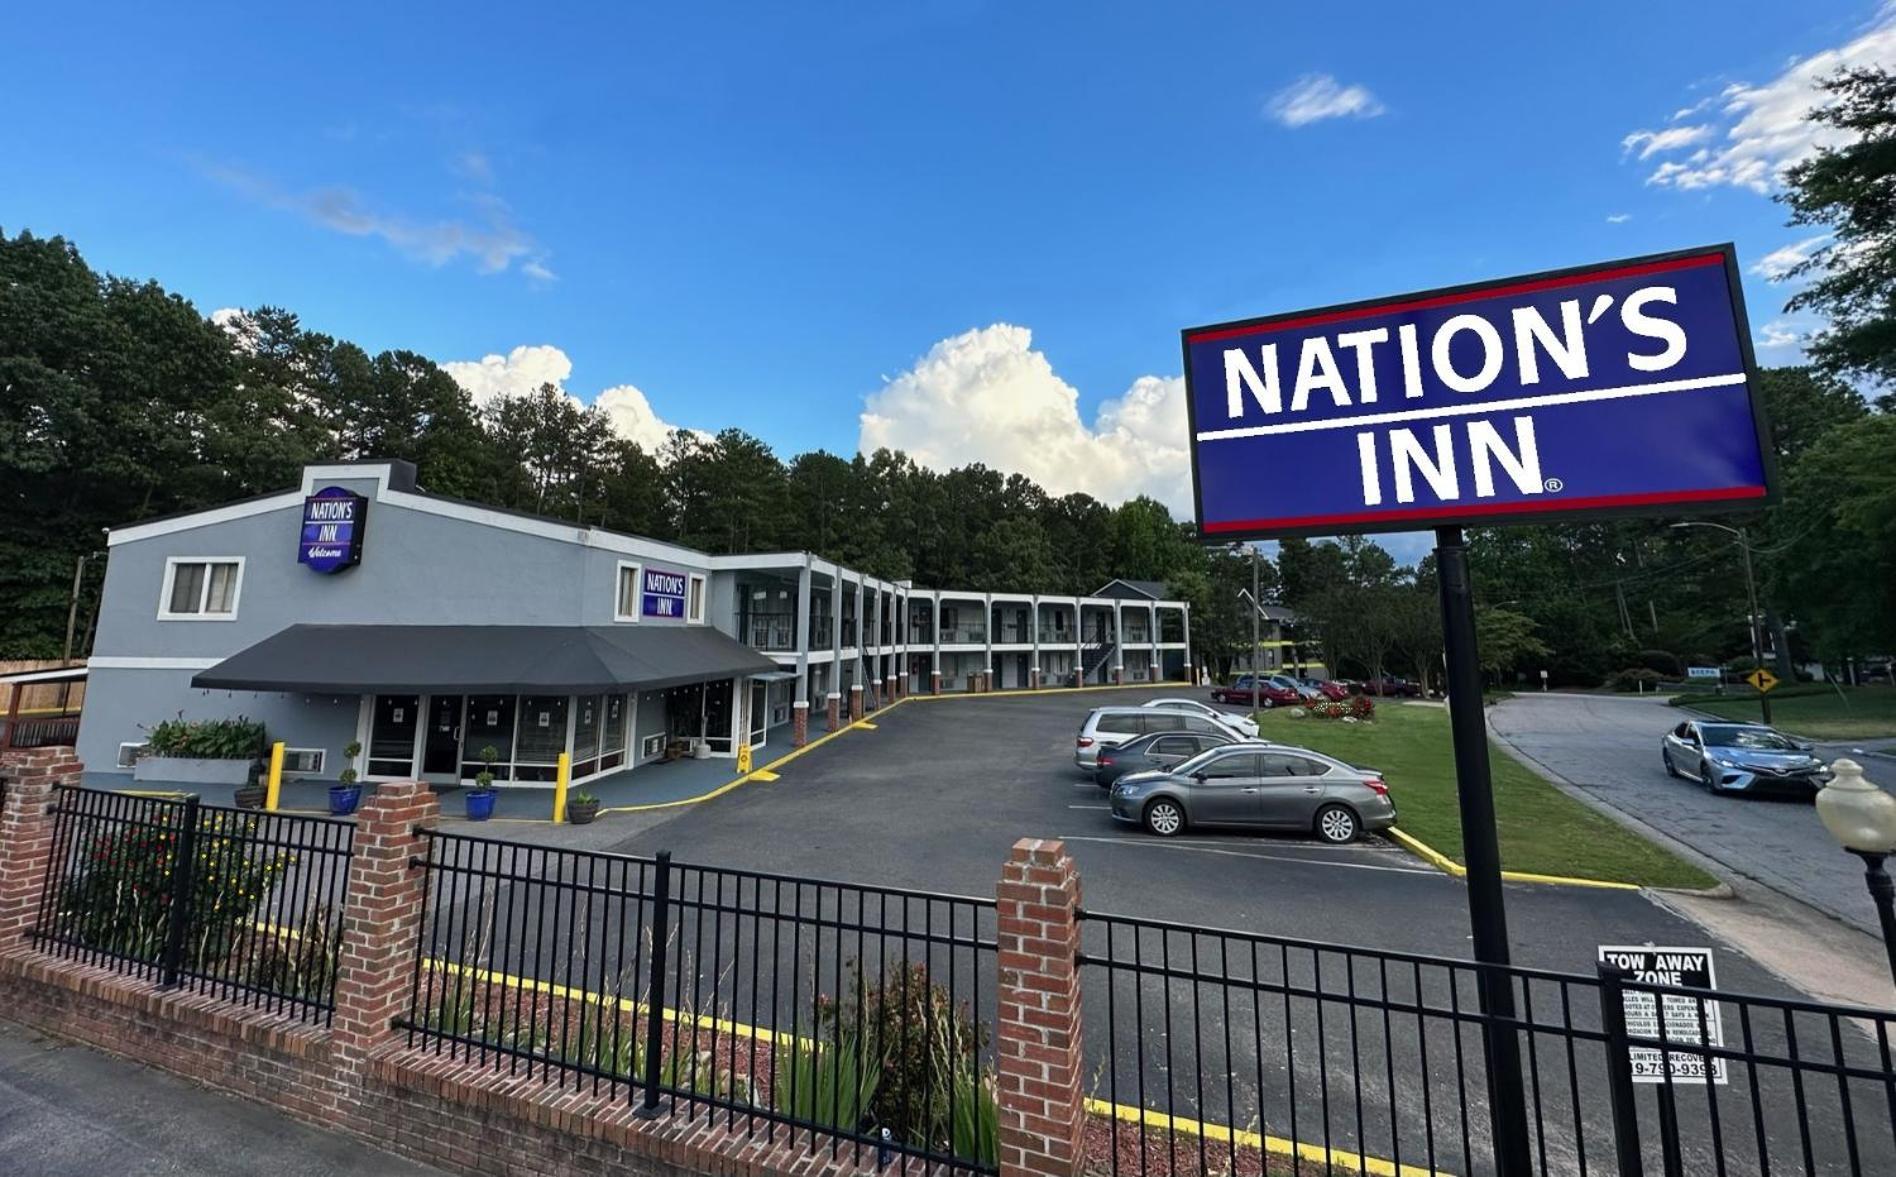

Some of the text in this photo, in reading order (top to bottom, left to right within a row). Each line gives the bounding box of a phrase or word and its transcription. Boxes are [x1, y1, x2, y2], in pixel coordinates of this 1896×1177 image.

[1223, 286, 1687, 418] NATION'S
[310, 501, 353, 519] NATION'S
[319, 524, 338, 541] INN
[308, 546, 342, 558] Welcome
[647, 572, 683, 594] NATION'S
[657, 597, 672, 616] INN
[1606, 953, 1704, 971] TOW AWAY
[1634, 970, 1683, 987] ZONE
[1629, 1053, 1662, 1061] IMITED
